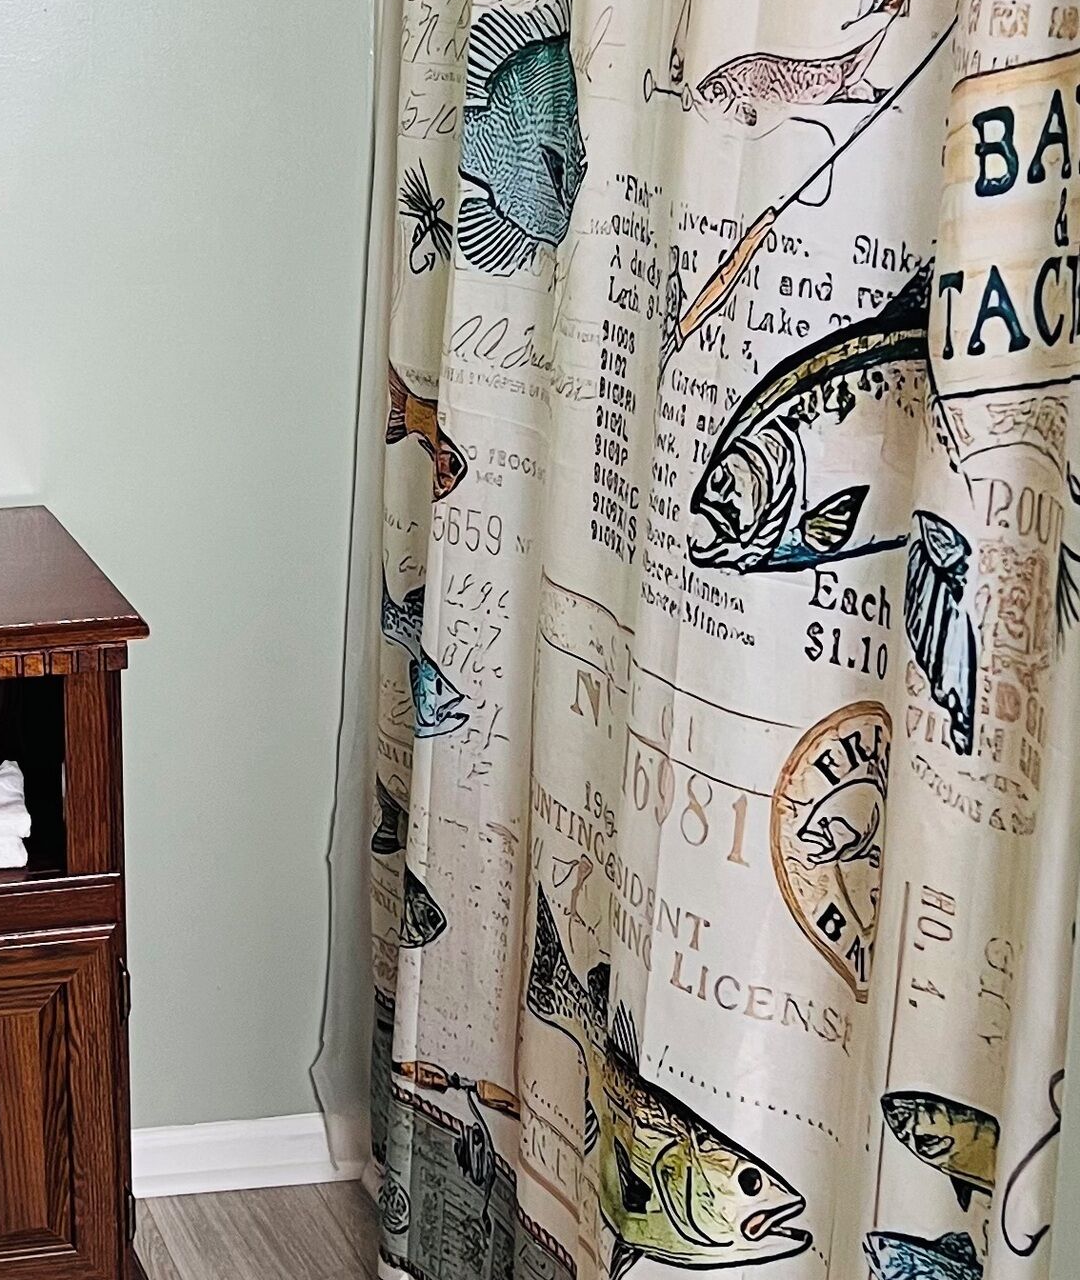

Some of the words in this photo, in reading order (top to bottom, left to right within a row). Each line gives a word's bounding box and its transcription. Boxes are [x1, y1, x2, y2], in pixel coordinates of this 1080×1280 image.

[971, 84, 1080, 197] BA
[778, 272, 834, 301] and
[746, 300, 811, 338] Lake
[808, 569, 891, 630] Each
[804, 621, 889, 681] $1.10
